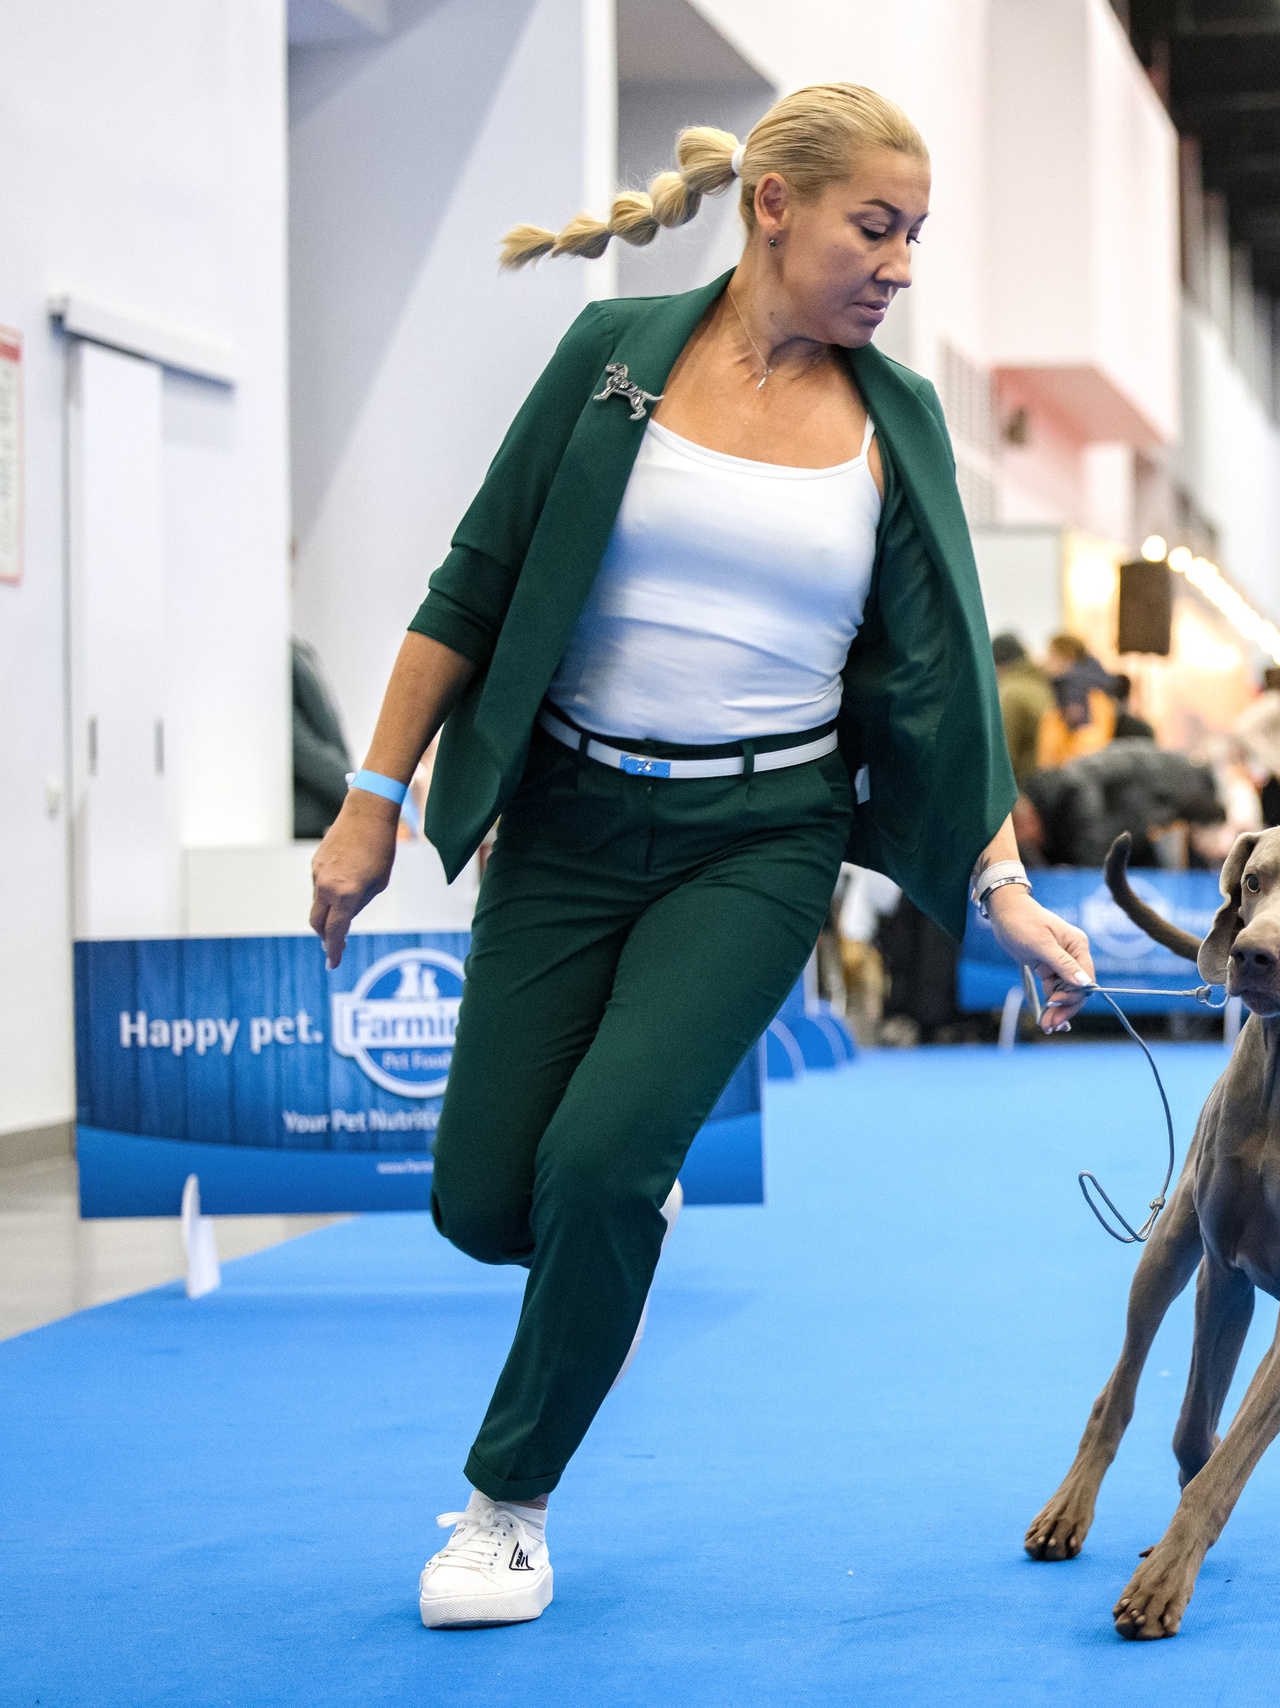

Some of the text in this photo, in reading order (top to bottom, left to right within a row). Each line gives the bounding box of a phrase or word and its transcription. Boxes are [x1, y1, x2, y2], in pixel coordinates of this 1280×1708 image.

[119, 1008, 325, 1056] Happy pet.
[283, 1110, 330, 1133] Your
[331, 1108, 366, 1133] Pet
